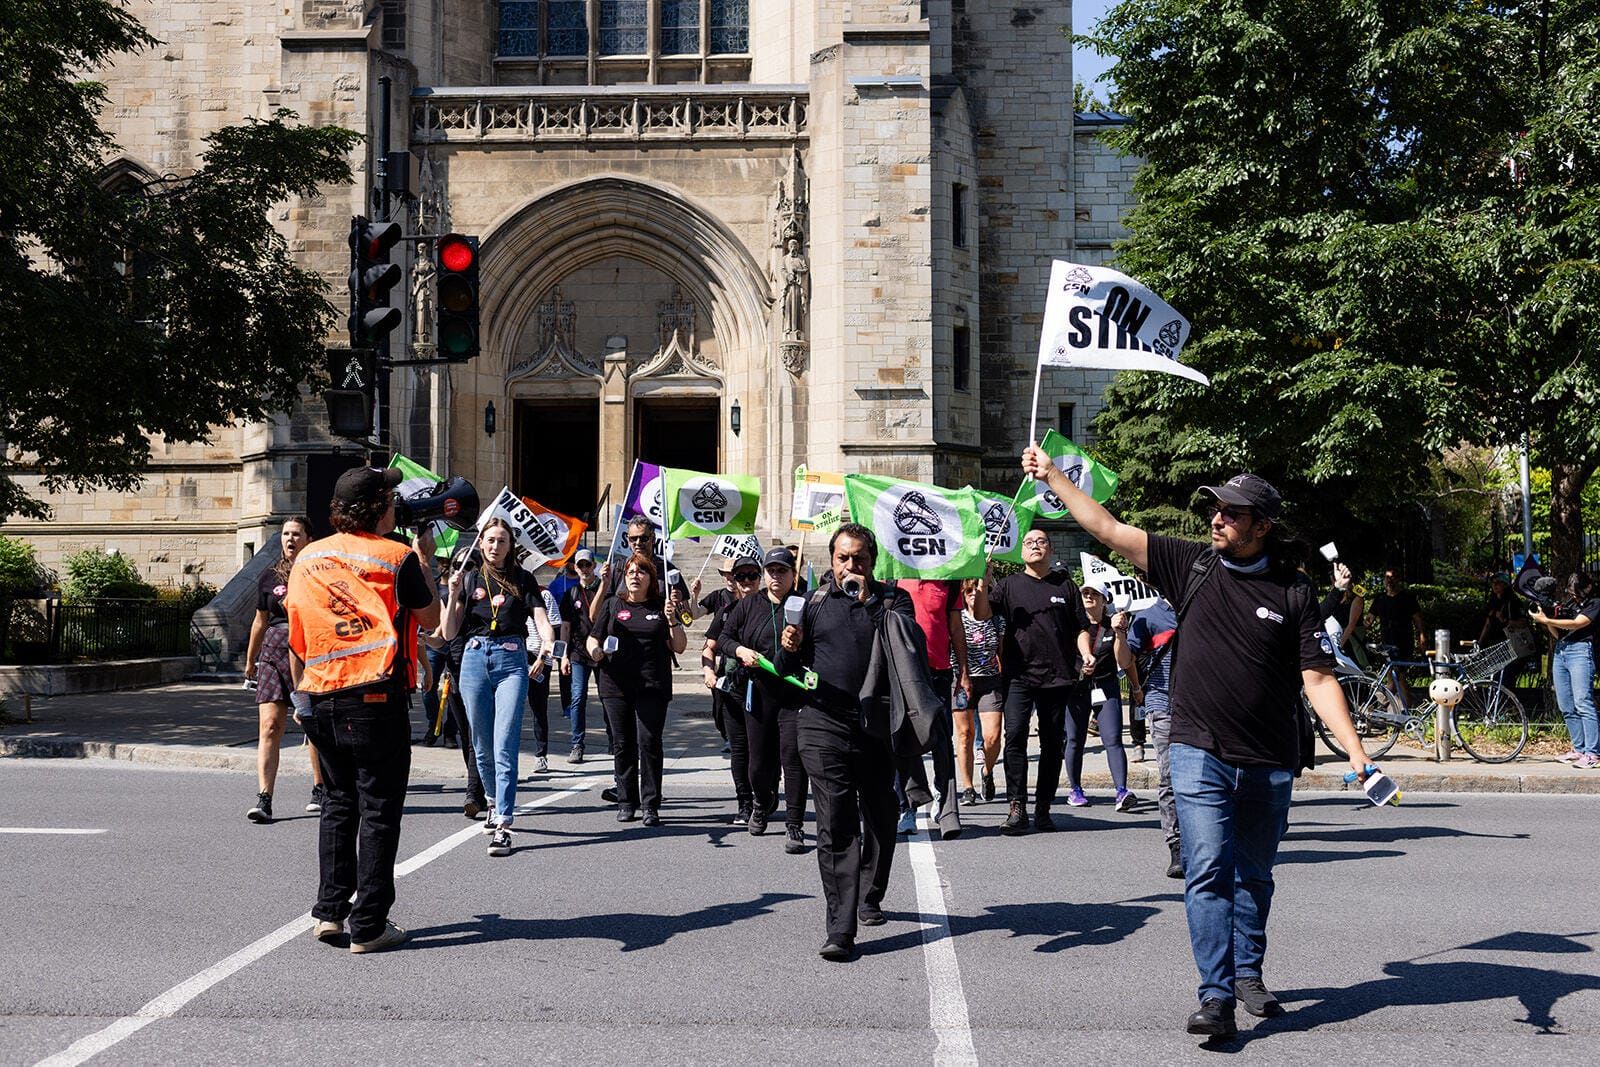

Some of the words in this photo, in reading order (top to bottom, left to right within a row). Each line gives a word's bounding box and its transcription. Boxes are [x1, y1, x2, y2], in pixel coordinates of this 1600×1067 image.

[1063, 283, 1090, 295] CSN
[1102, 286, 1152, 337] ON
[499, 492, 521, 513] ON
[693, 511, 726, 523] CSN
[821, 511, 833, 519] ON
[815, 515, 840, 529] STRIKE
[724, 535, 739, 548] ON
[897, 537, 947, 556] CSN
[721, 546, 735, 558] EN
[1091, 566, 1107, 574] CSN
[335, 615, 373, 637] CSN
